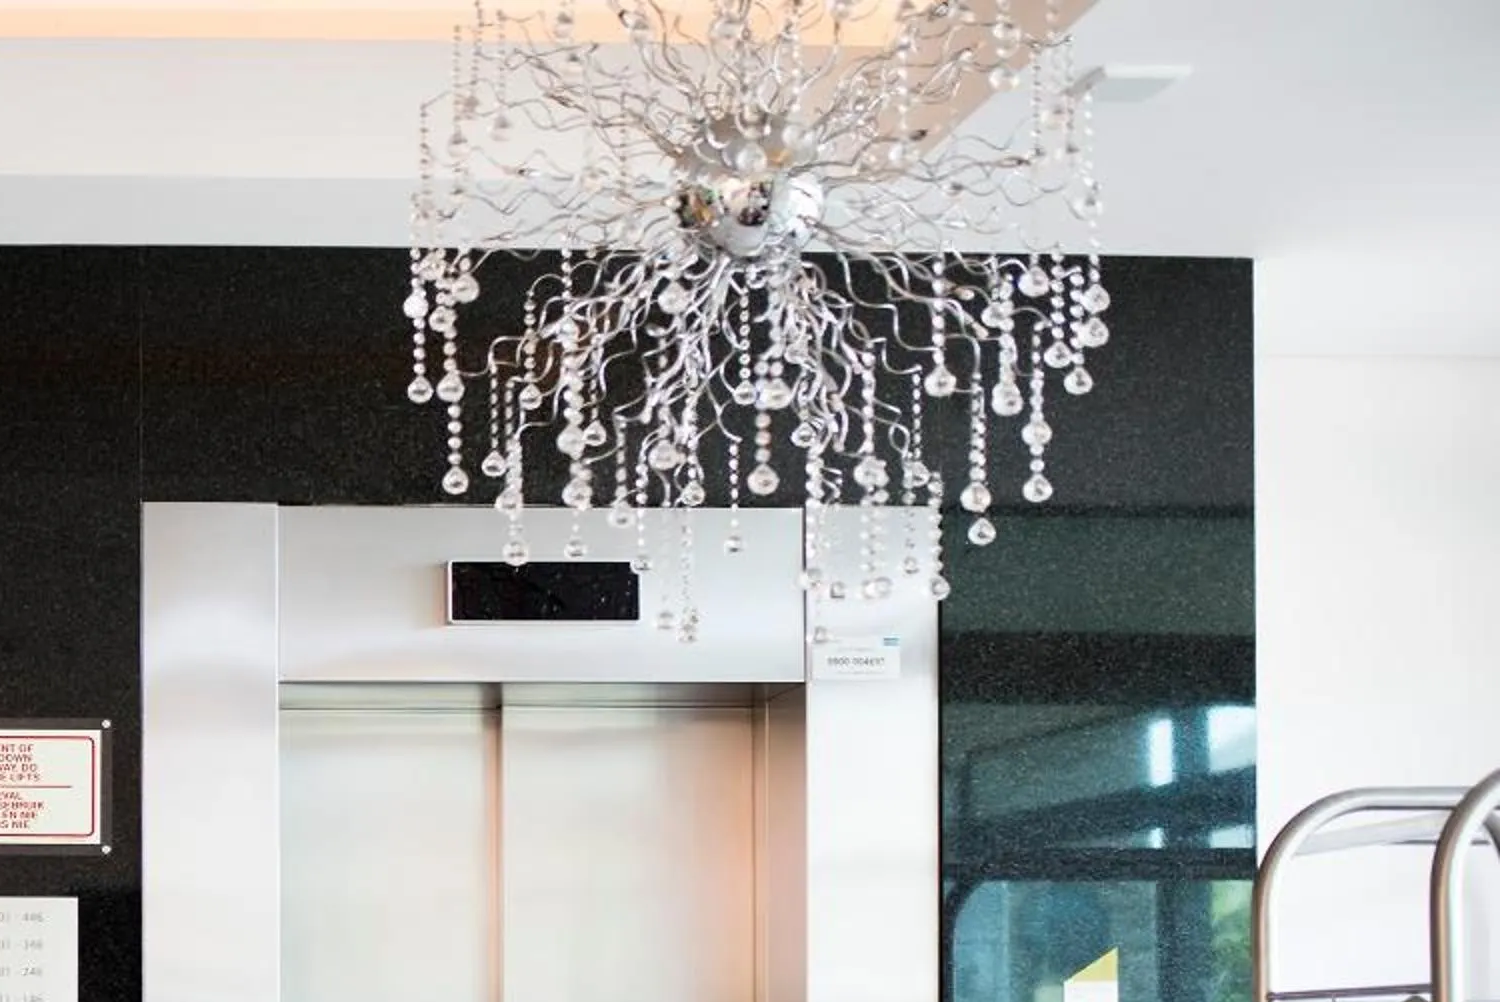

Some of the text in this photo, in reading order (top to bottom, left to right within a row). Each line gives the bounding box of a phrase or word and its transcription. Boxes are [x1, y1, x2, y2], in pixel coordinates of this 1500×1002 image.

[18, 744, 34, 753] OF
[21, 763, 38, 772] DO
[9, 772, 42, 782] LIFTS
[11, 820, 30, 828] NIE
